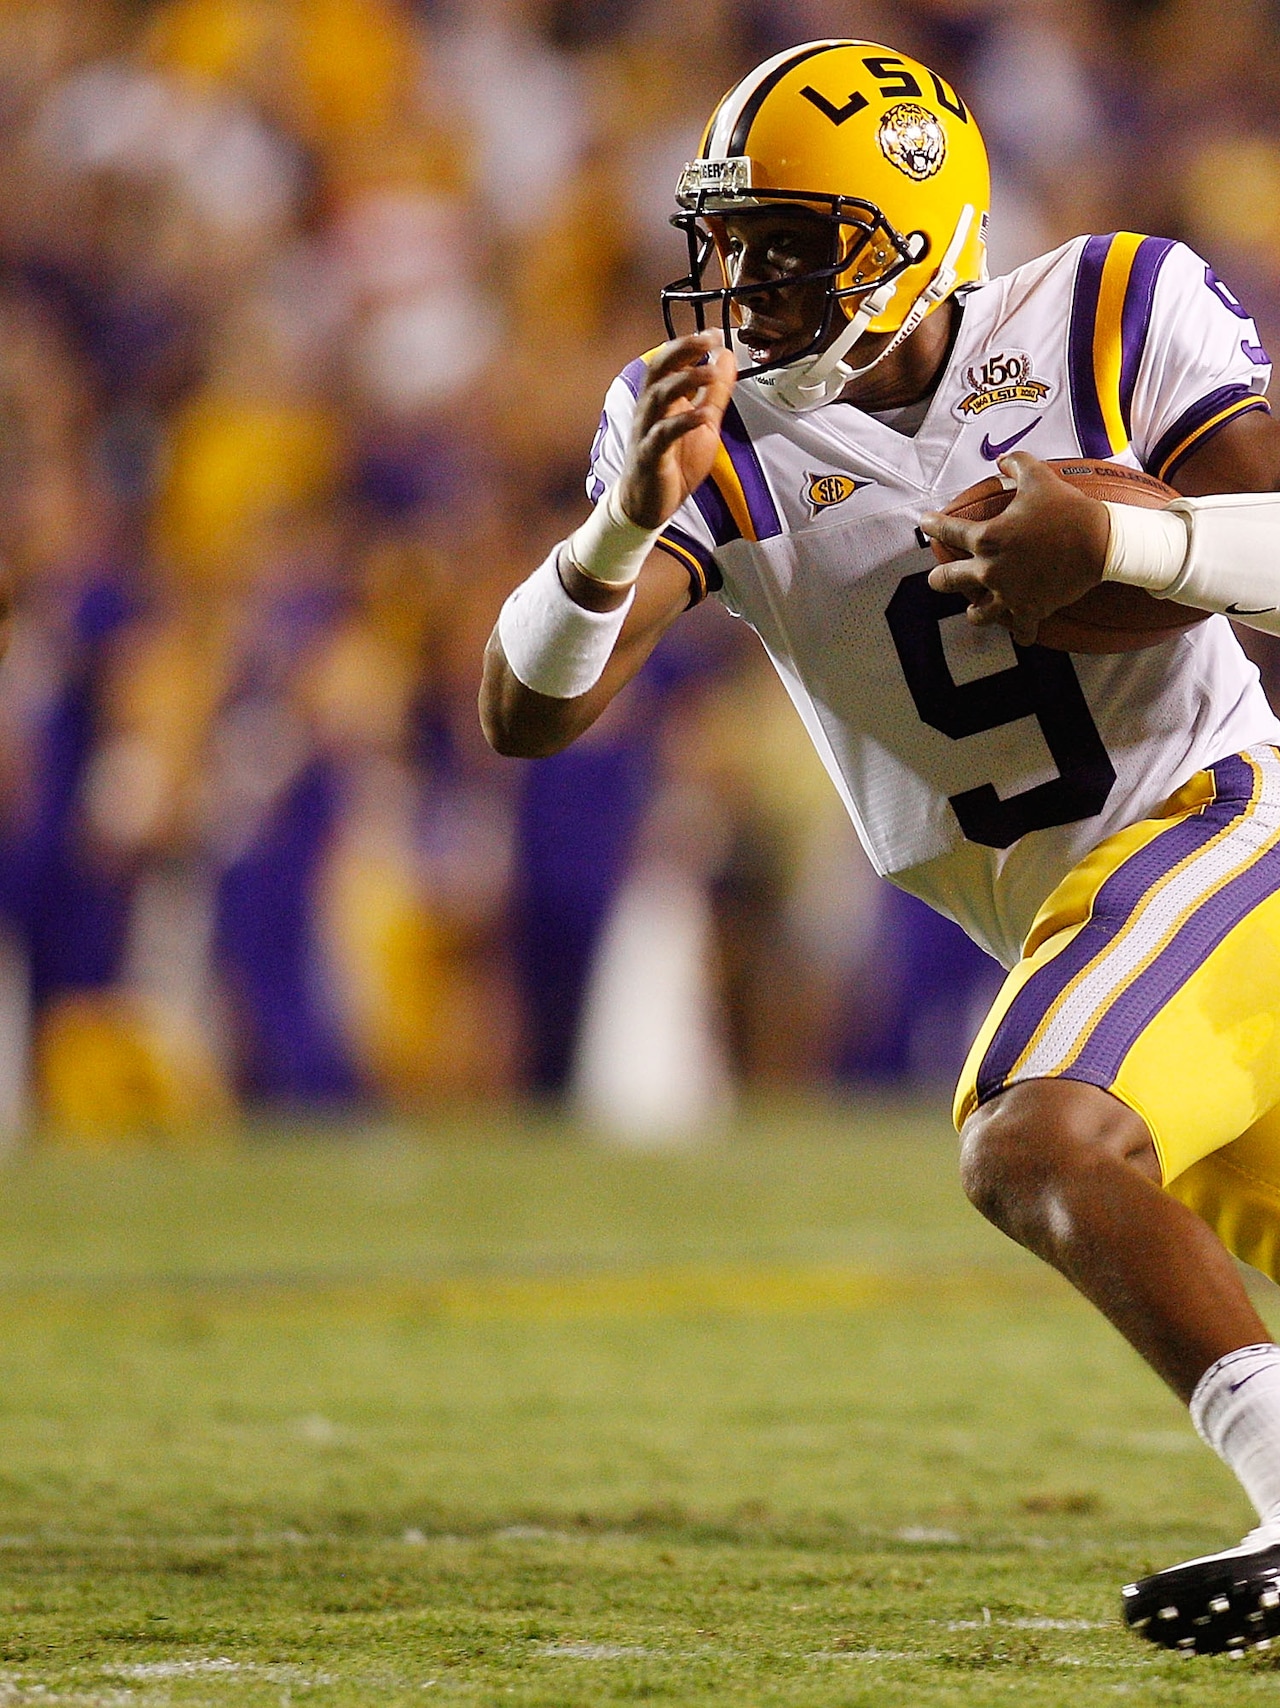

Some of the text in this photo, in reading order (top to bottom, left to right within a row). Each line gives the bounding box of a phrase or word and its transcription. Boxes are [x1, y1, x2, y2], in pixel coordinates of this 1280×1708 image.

[799, 57, 968, 125] LSU
[980, 353, 1021, 386] 150
[989, 386, 1018, 402] LSU
[818, 478, 844, 502] SEC
[885, 570, 1117, 850] 9
